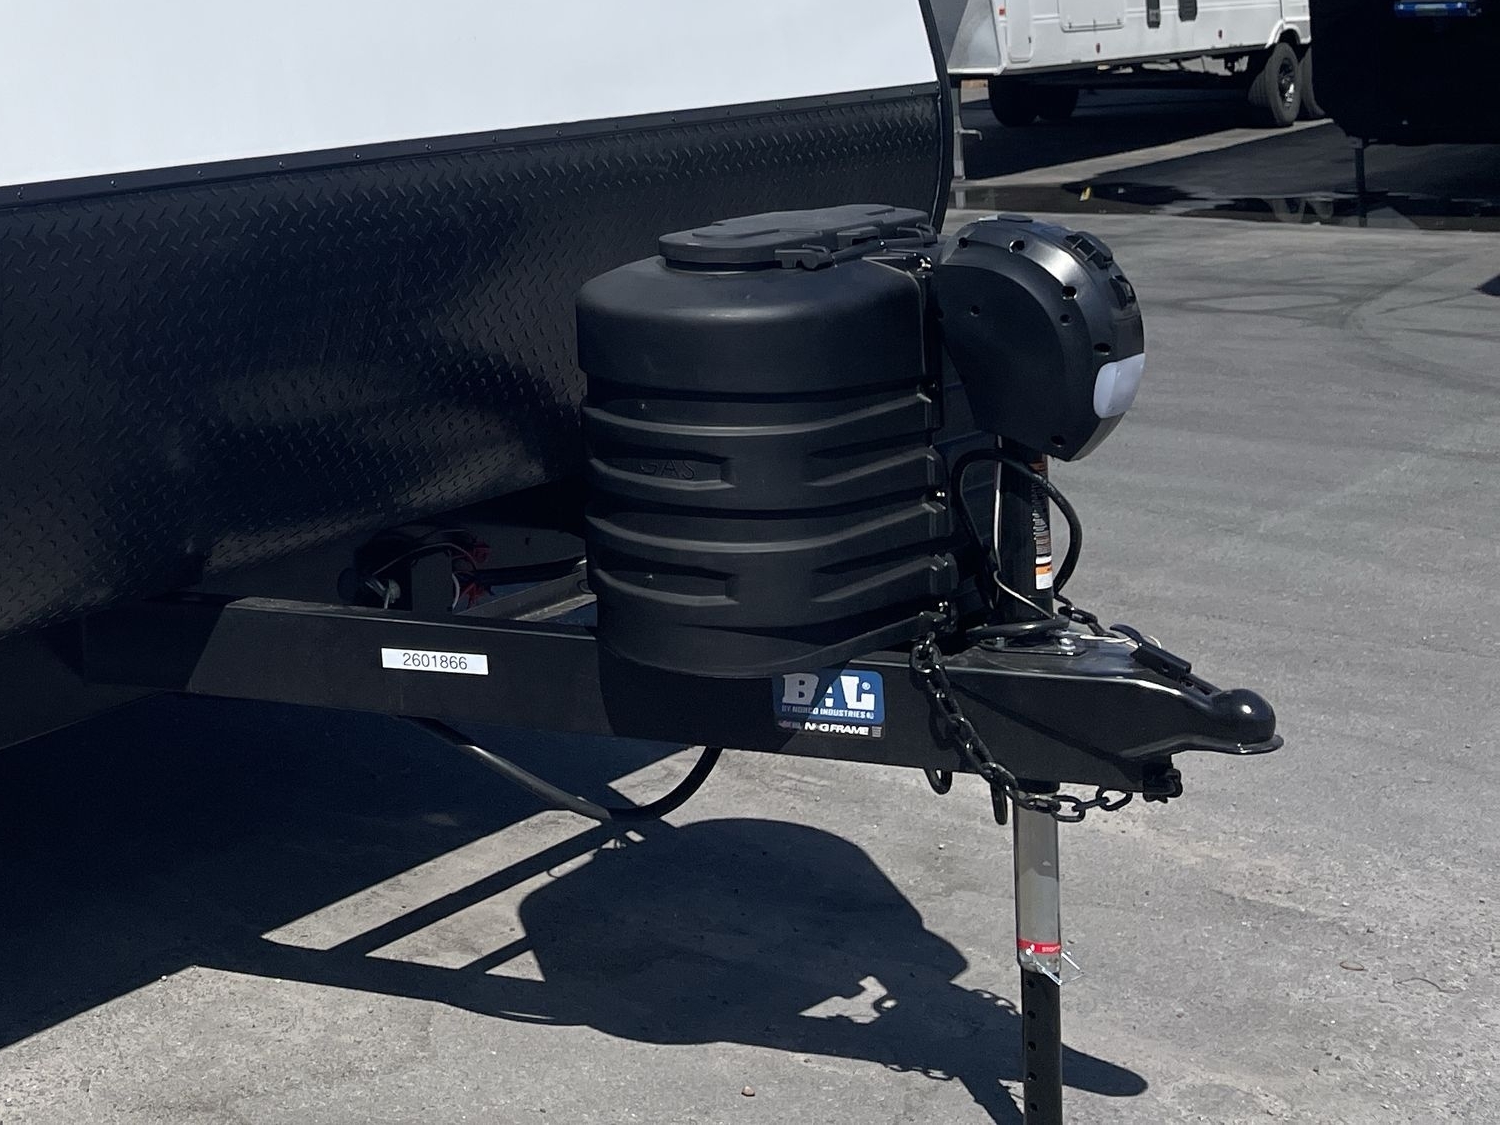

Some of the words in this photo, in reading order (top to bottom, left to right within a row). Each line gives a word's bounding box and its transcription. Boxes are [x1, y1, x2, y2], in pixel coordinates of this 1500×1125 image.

[402, 652, 468, 670] 2601866
[781, 672, 876, 711] BAL
[819, 707, 866, 719] INDUSTRIES
[829, 724, 870, 736] FRAME
